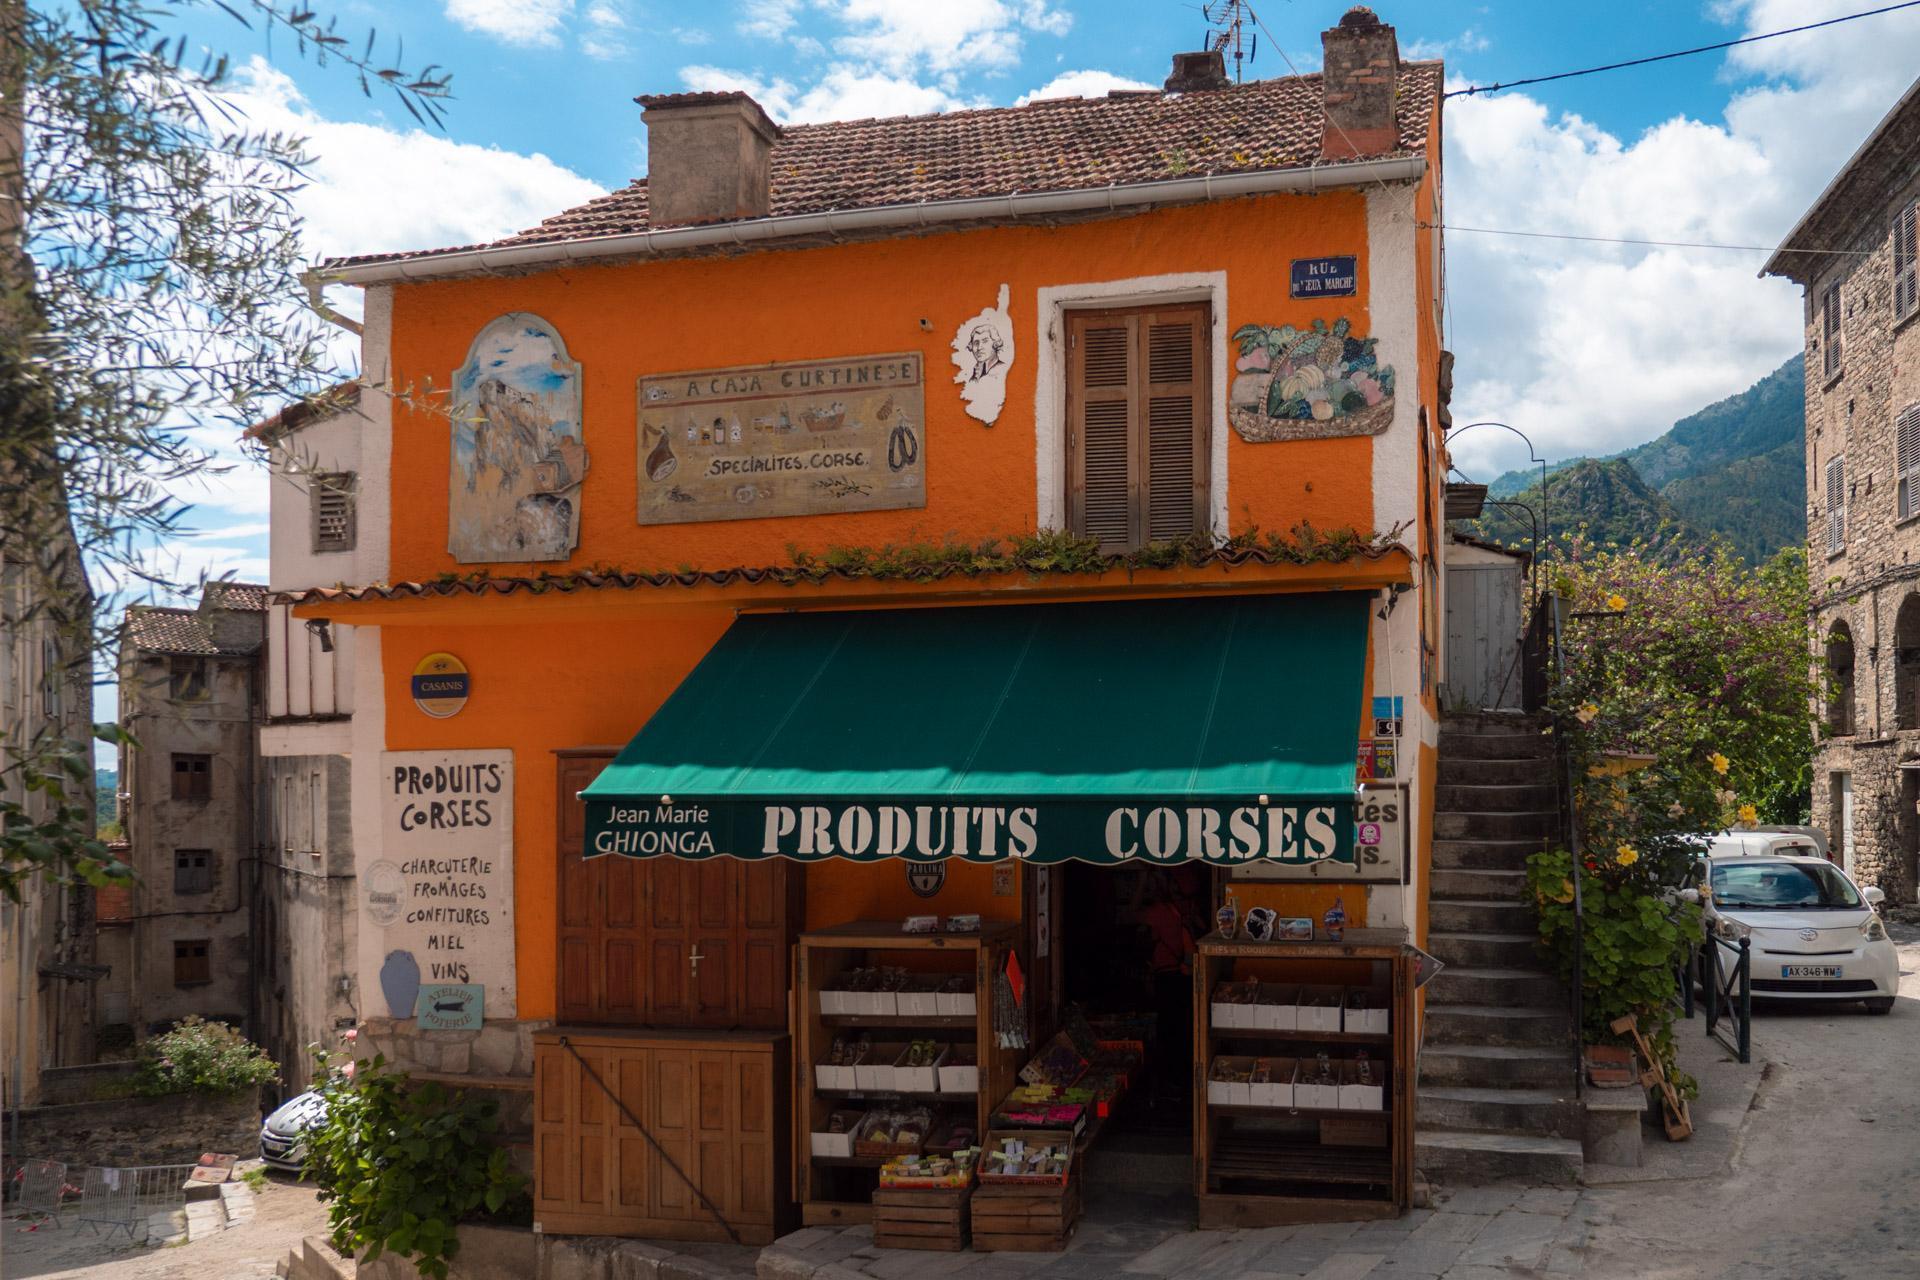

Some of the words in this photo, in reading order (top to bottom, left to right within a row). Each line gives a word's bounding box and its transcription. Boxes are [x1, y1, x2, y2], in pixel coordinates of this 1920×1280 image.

[687, 381, 700, 397] A
[710, 375, 763, 394] CASA
[780, 362, 912, 388] CURTINESE
[421, 680, 464, 691] CASANIS
[394, 764, 501, 794] PRODUITS
[400, 800, 492, 831] CORSES
[606, 806, 650, 823] Jean
[655, 805, 709, 823] Marie
[594, 831, 715, 853] GHIONGA
[761, 806, 1037, 857] PRODUITS
[1105, 806, 1336, 859] CORSES
[400, 857, 492, 876] CHARCUTERIE
[414, 882, 486, 899] FROMAGES
[406, 907, 490, 926] CONFITURES
[428, 935, 464, 950] MIEL
[431, 961, 469, 984] VINS
[428, 987, 473, 1004] ATELIER
[424, 1011, 472, 1028] POTERIE
